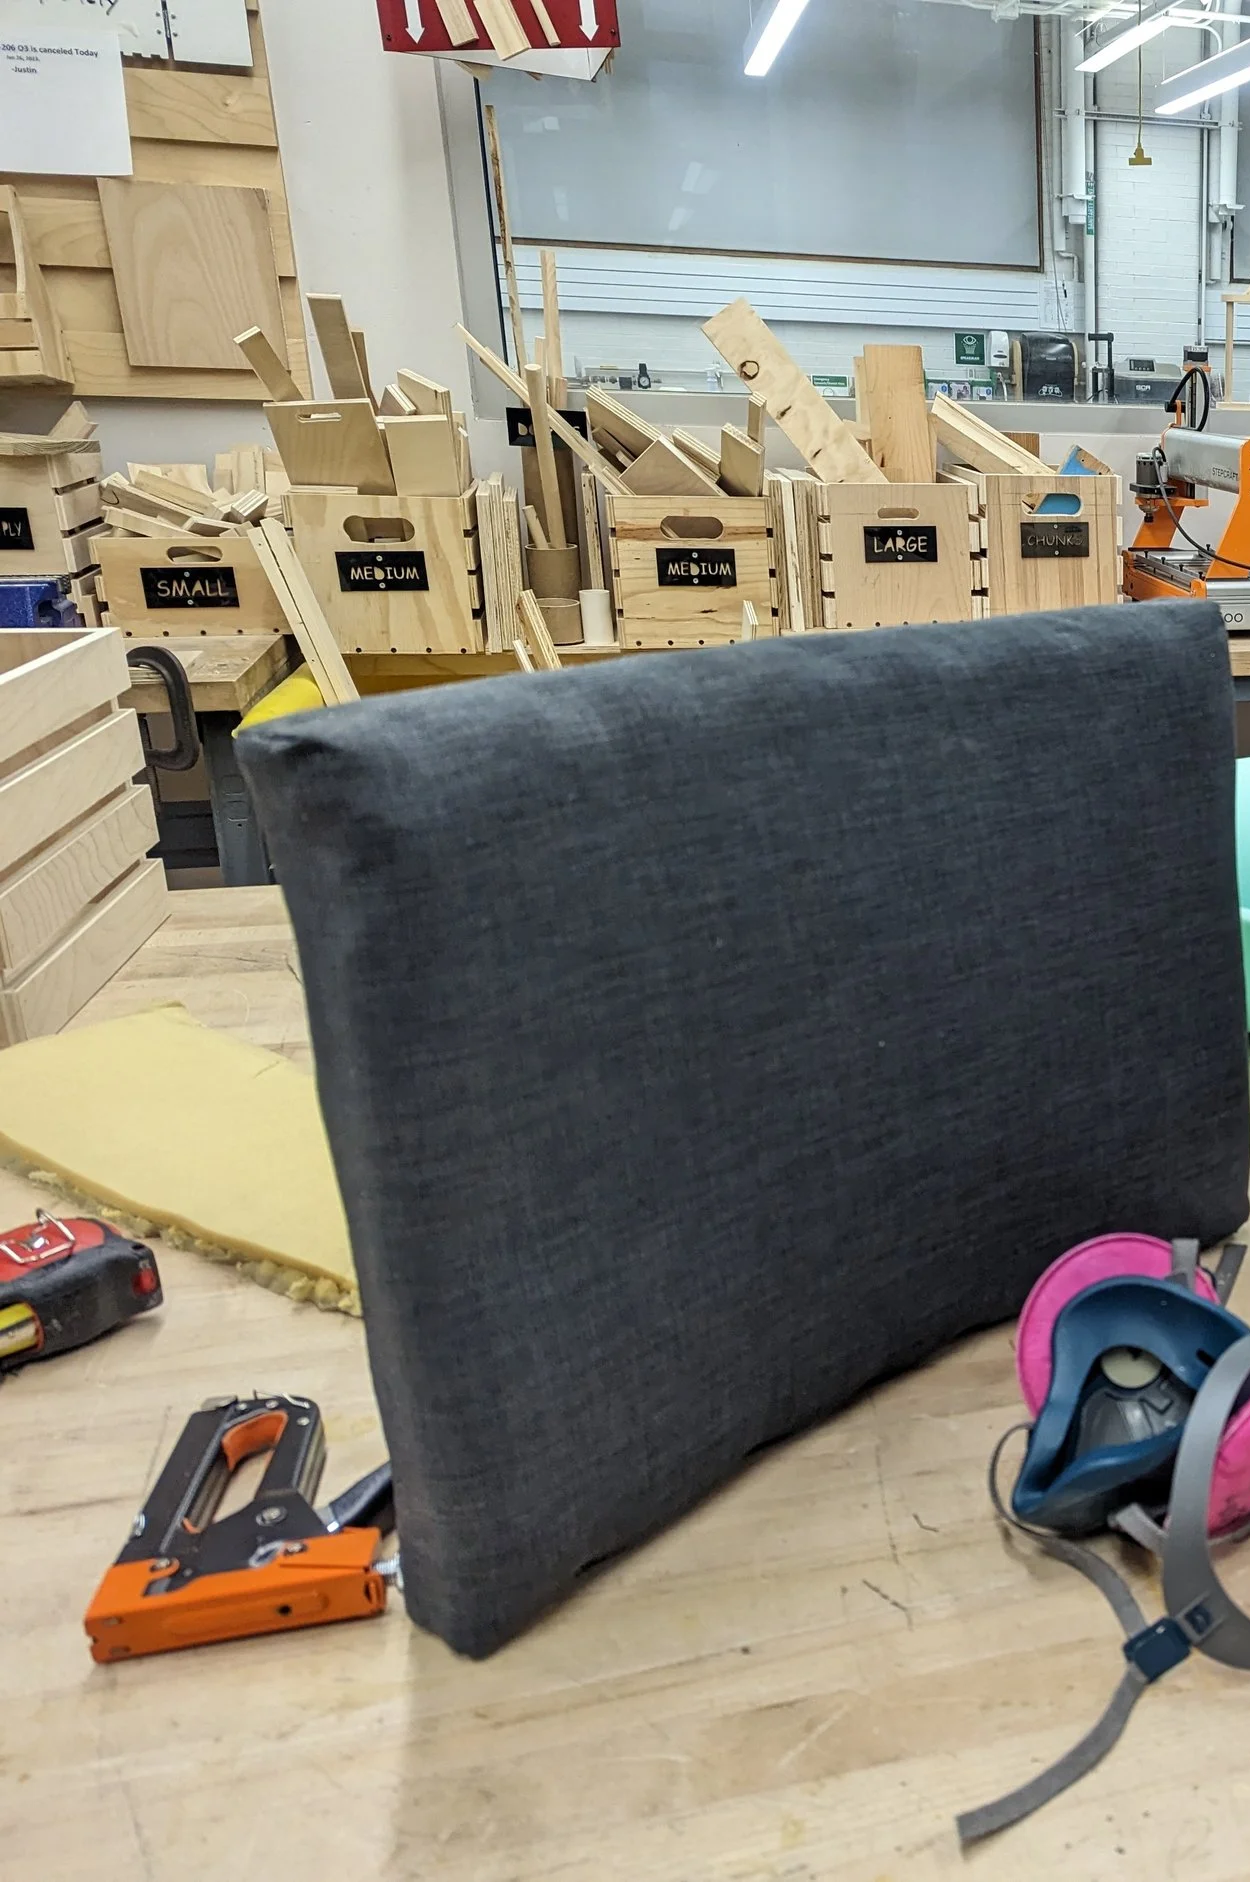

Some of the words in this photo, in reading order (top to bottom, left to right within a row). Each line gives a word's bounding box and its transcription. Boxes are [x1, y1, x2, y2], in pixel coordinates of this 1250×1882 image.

[30, 45, 38, 53] is
[39, 47, 73, 55] canceled
[74, 49, 98, 58] Today
[873, 536, 928, 553] LARGE
[350, 566, 420, 580] MEDIUM
[667, 562, 732, 576] MEDIUM
[157, 579, 229, 597] SMALL
